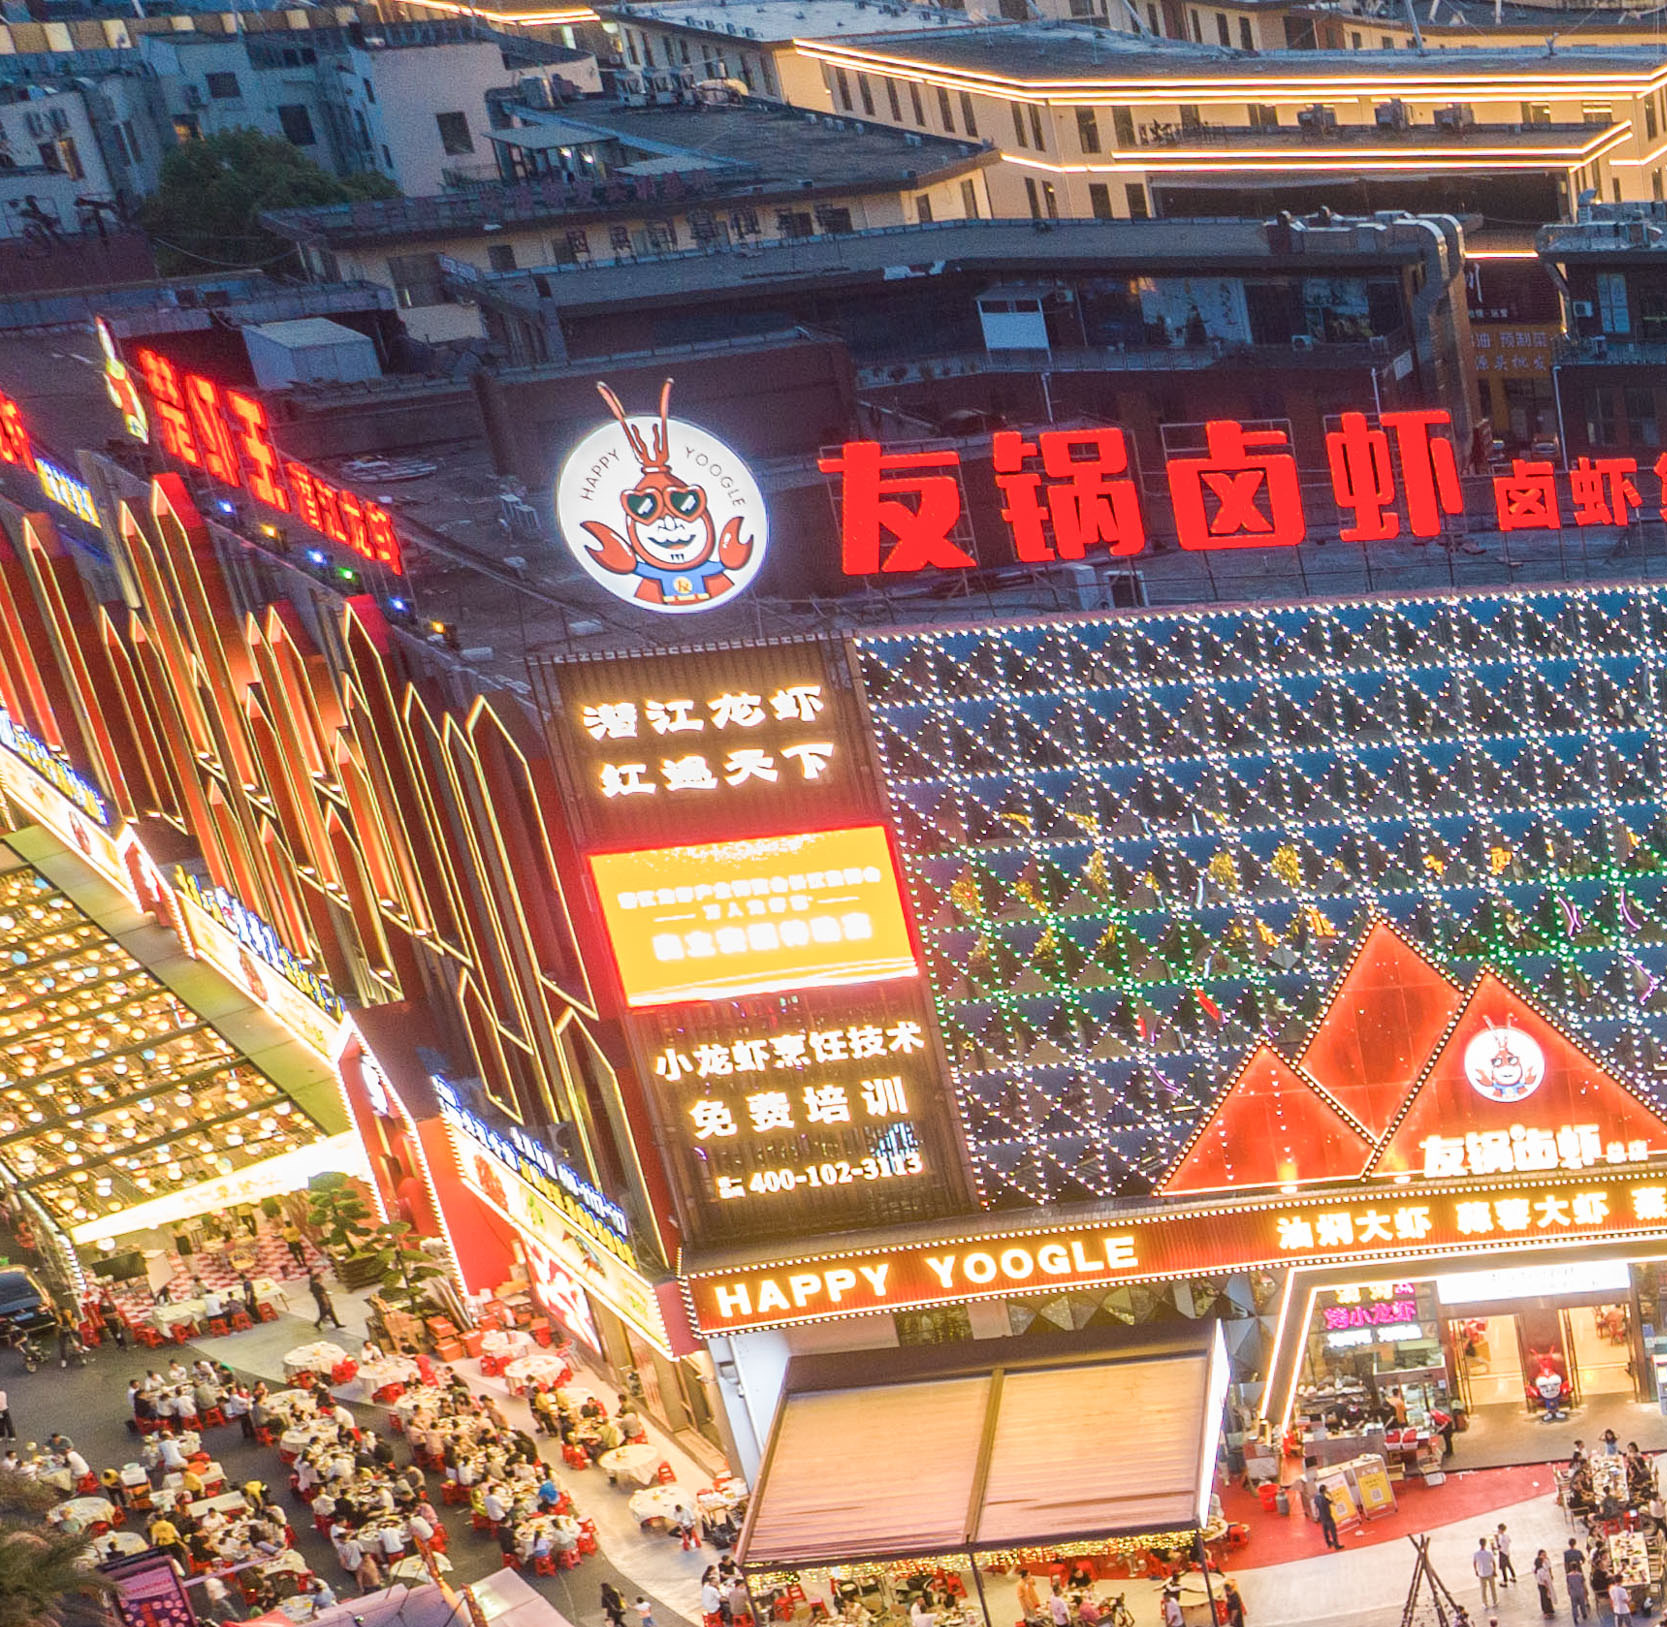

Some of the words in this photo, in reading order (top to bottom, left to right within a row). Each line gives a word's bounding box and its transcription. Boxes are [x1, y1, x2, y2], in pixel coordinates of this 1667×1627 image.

[1500, 331, 1547, 348] 预制菜
[580, 449, 620, 501] HAPPY
[685, 447, 746, 506] YOOGLE
[817, 411, 1464, 575] 友锅卤虾
[583, 685, 824, 740] 潜江龙虾
[600, 743, 834, 797] 红遍天下
[655, 1021, 925, 1082] 小龙虾烹饪技术
[689, 1076, 909, 1139] 免费培训
[1276, 1206, 1432, 1250] 油焖大虾
[1455, 1191, 1610, 1235] 蒜蓉大虾
[714, 1263, 889, 1317] HAPPY
[926, 1236, 1138, 1288] YOOGLE
